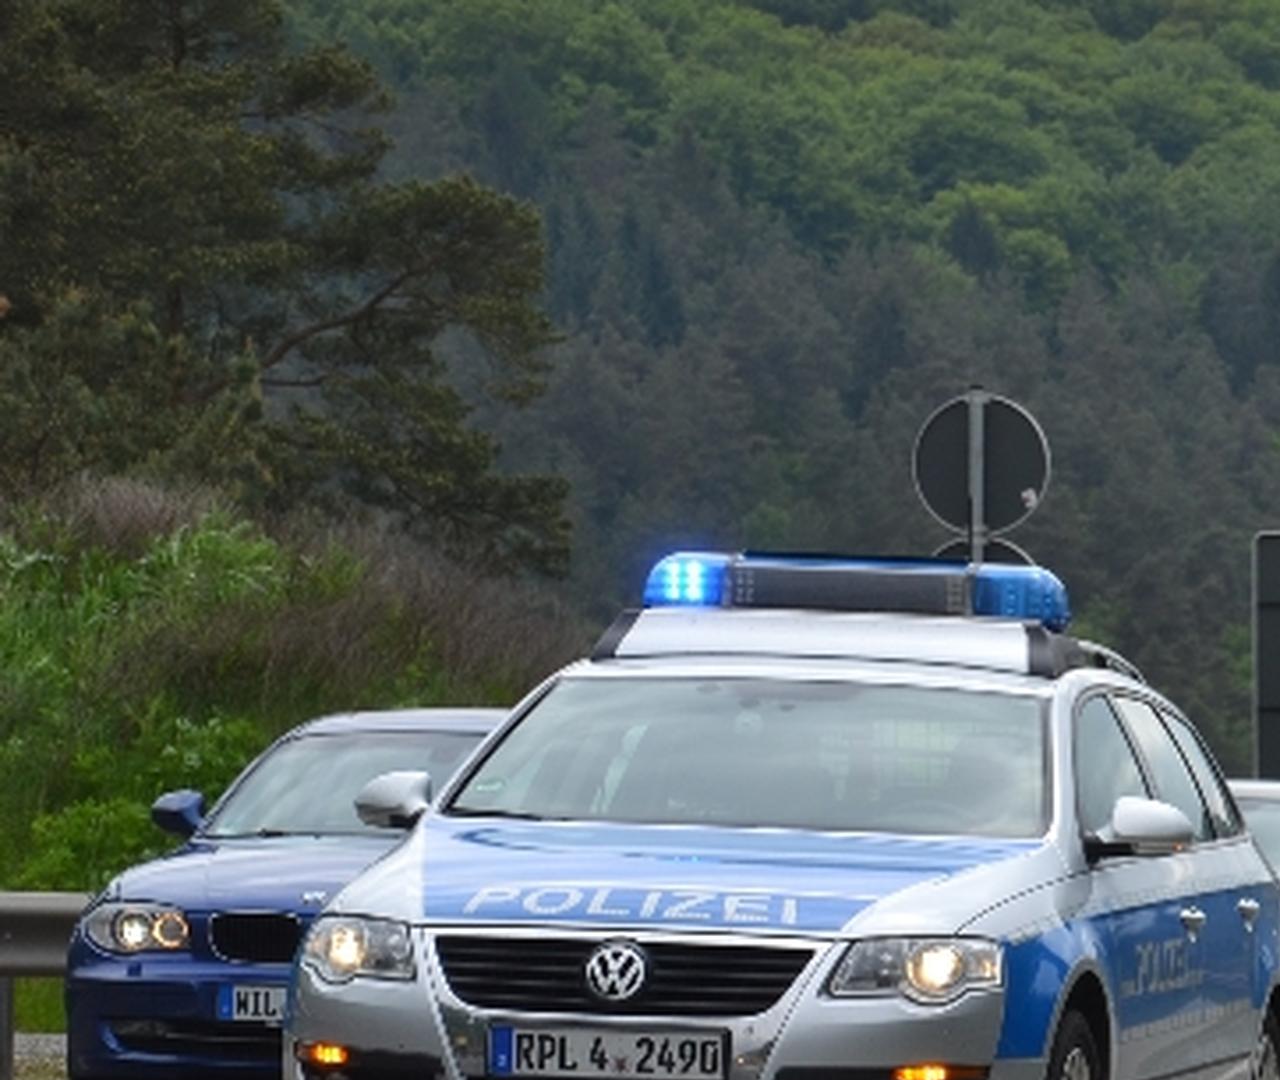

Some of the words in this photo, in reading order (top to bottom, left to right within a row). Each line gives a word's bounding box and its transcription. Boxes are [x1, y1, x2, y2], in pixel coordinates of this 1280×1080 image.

[462, 887, 798, 924] POLIZEI
[236, 991, 277, 1016] WIL
[516, 1033, 577, 1070] RPL
[589, 1039, 608, 1071] 4
[635, 1040, 718, 1075] 2490
